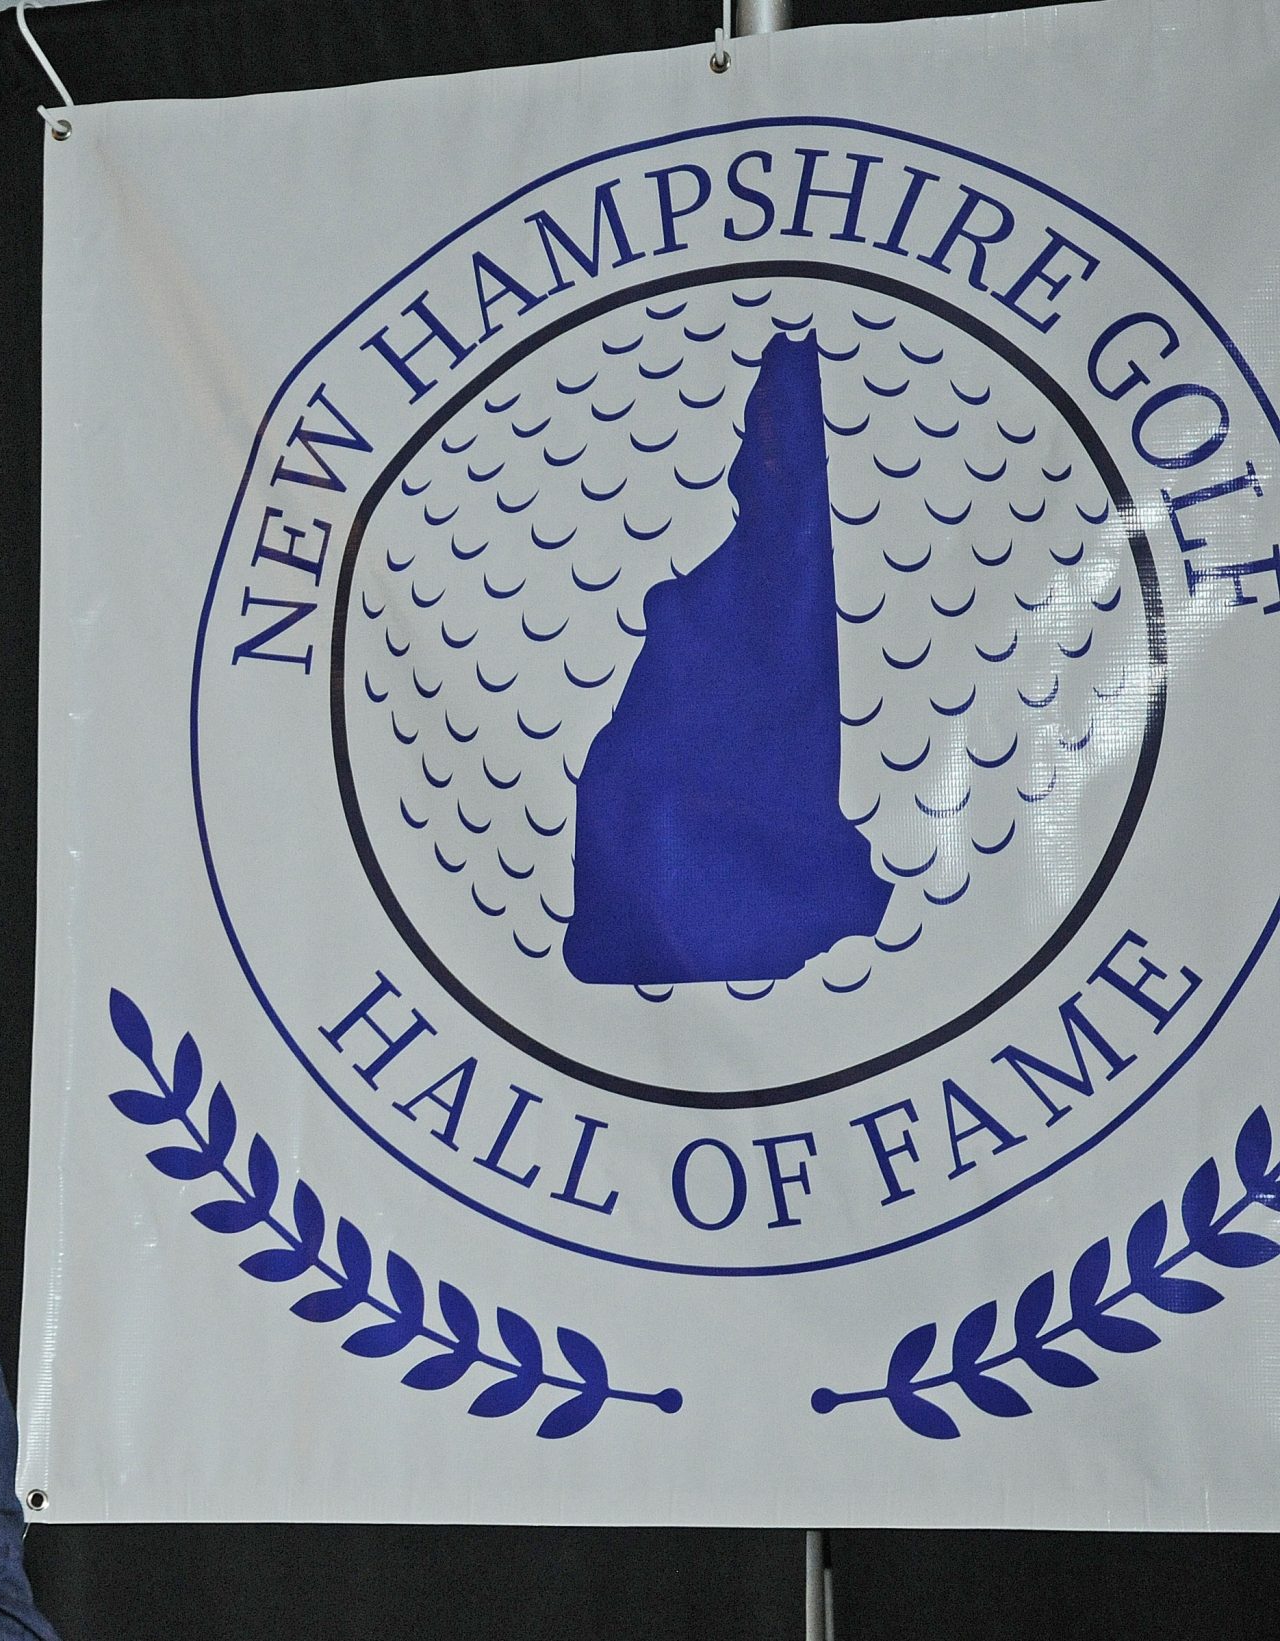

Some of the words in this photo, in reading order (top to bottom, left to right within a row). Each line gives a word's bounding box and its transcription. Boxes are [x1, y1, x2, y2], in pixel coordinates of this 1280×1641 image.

[231, 383, 373, 676] NEW
[361, 147, 1100, 406] HAMPSHIRE
[1087, 311, 1280, 615] GOLF
[318, 969, 619, 1216] HALL
[671, 1132, 818, 1231] OF
[851, 928, 1204, 1207] FAME
